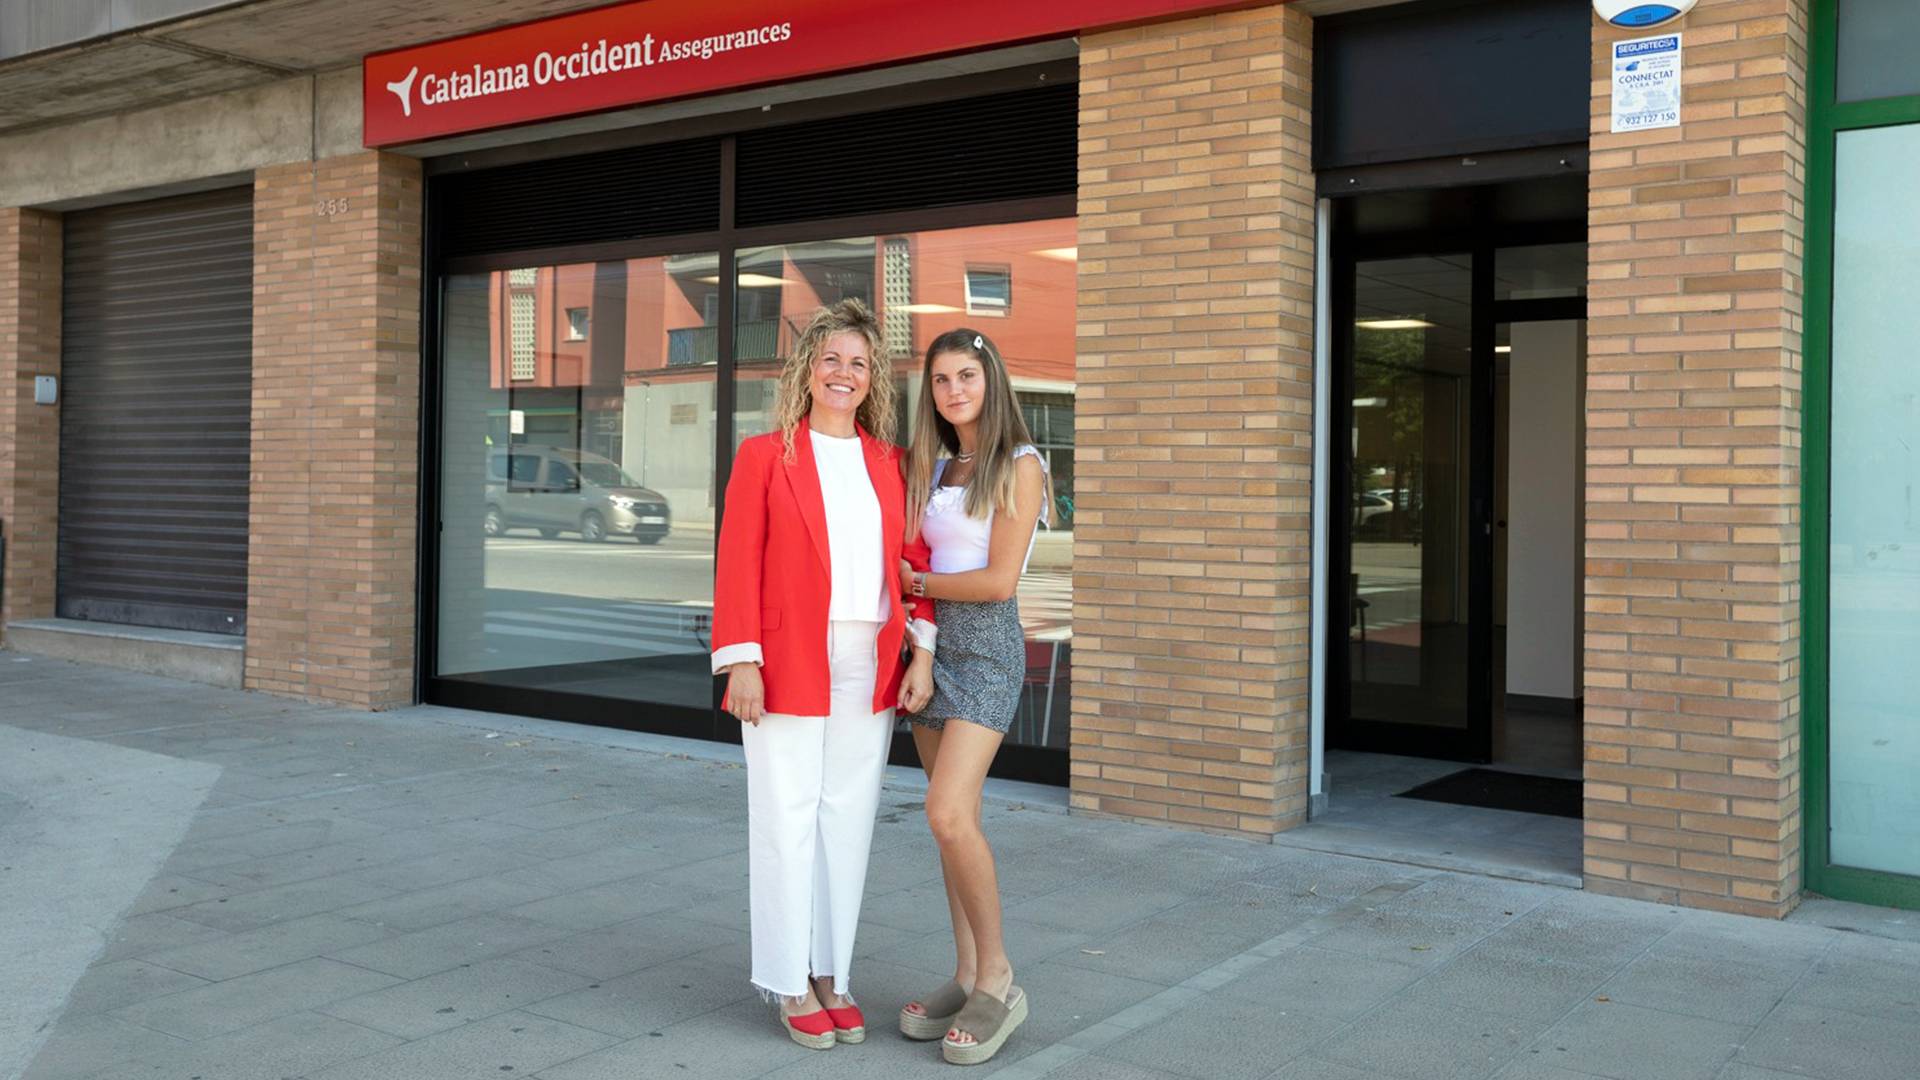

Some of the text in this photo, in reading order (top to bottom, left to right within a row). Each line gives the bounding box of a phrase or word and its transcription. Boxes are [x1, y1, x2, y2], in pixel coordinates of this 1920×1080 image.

[1618, 39, 1675, 53] SEGURITECSA
[420, 22, 791, 105] Catalana Occident Assegurances
[1618, 70, 1674, 84] CONNECTAT
[1625, 116, 1640, 125] 932
[1644, 114, 1658, 123] 127
[1661, 111, 1677, 121] 150
[318, 197, 347, 217] 255
